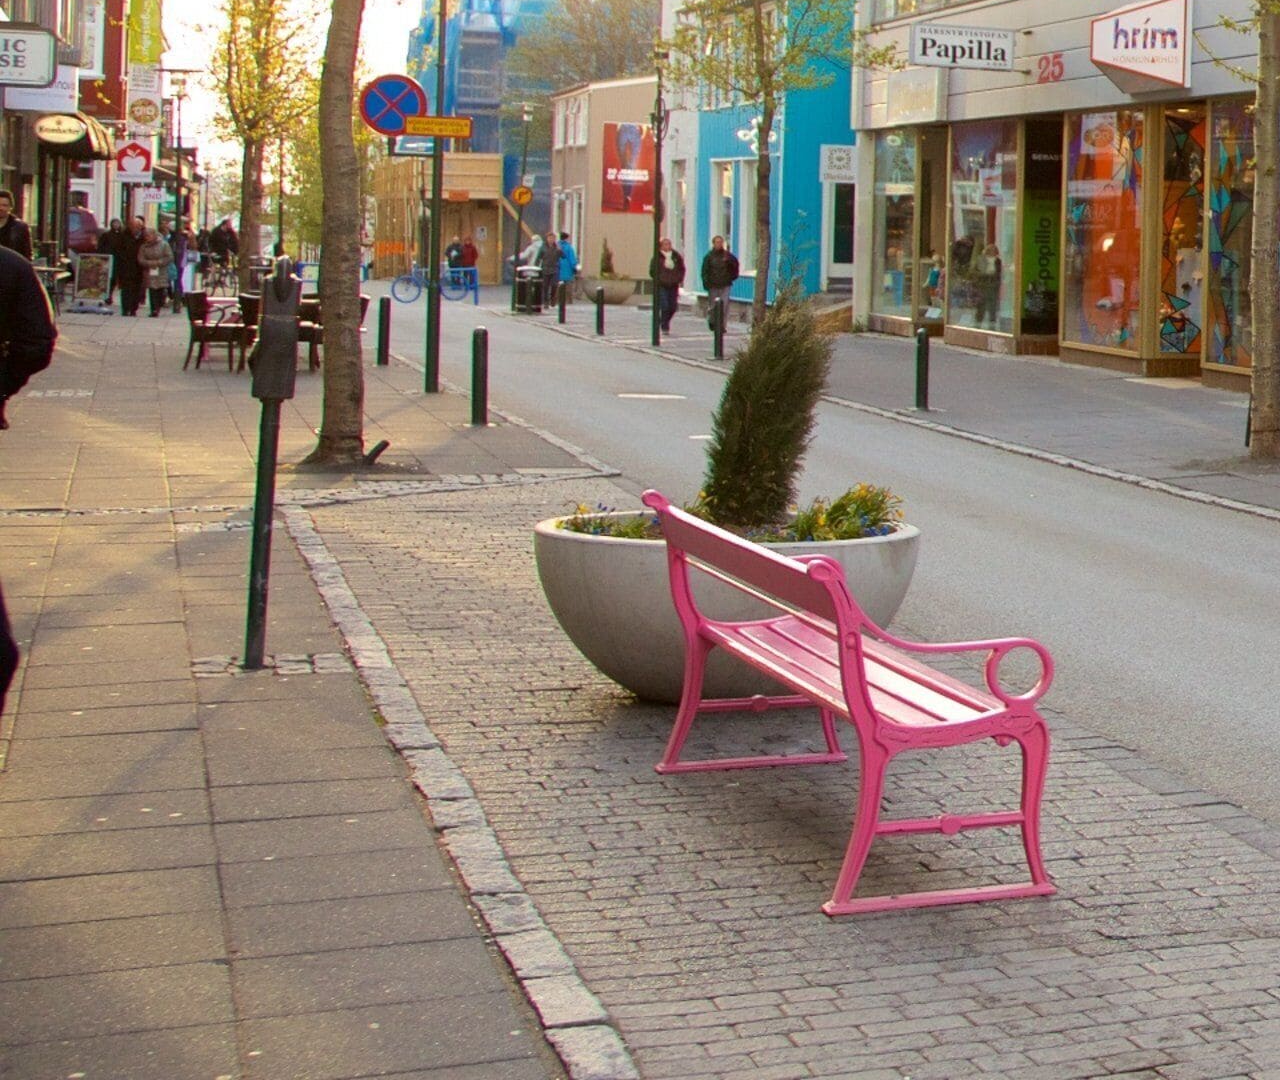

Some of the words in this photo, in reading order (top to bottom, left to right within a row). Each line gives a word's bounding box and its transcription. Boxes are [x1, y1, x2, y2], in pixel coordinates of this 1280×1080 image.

[1113, 17, 1178, 49] hrím
[920, 37, 1007, 64] Papilla
[1037, 51, 1064, 84] 25
